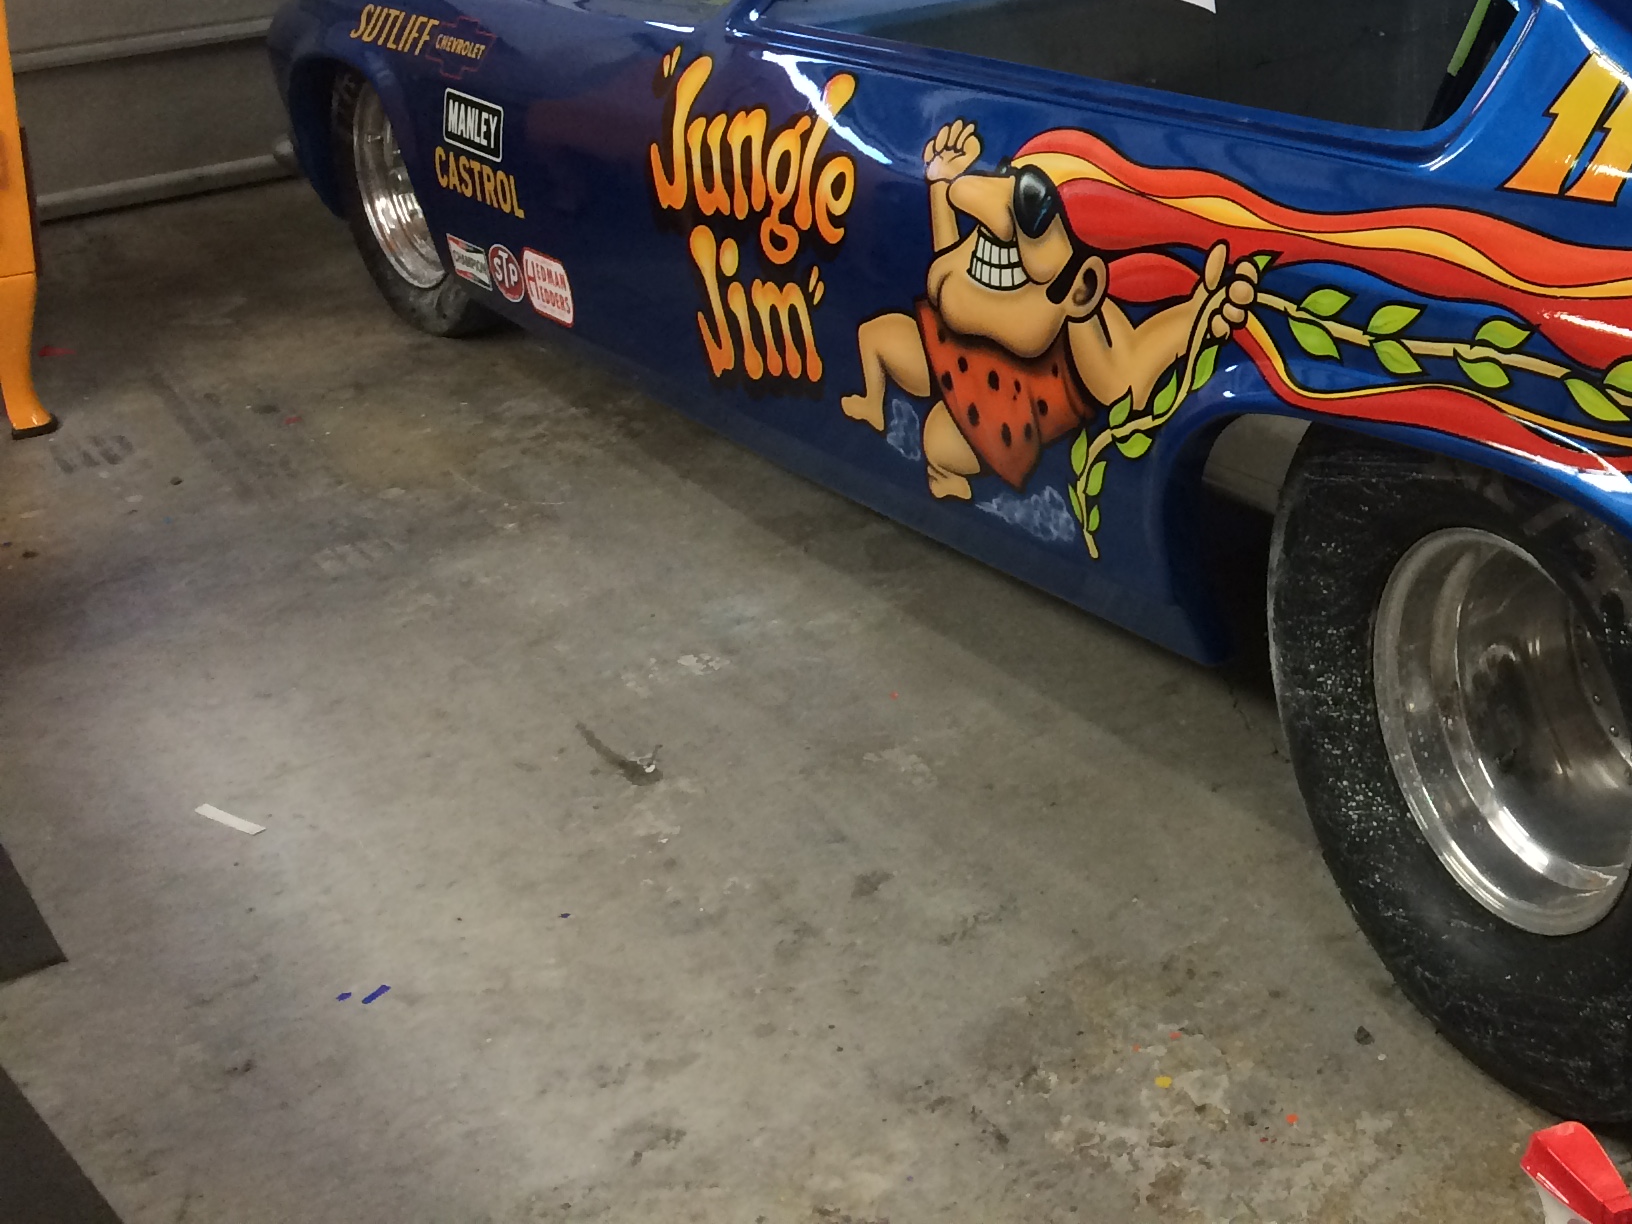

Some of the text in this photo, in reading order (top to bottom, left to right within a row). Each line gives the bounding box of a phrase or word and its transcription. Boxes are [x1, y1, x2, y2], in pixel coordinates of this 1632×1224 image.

[350, 3, 487, 60] SUTLIFF CHEVROLET
[447, 98, 499, 149] MANLEY
[434, 145, 526, 219] CASTROL
[493, 249, 519, 289] STP
